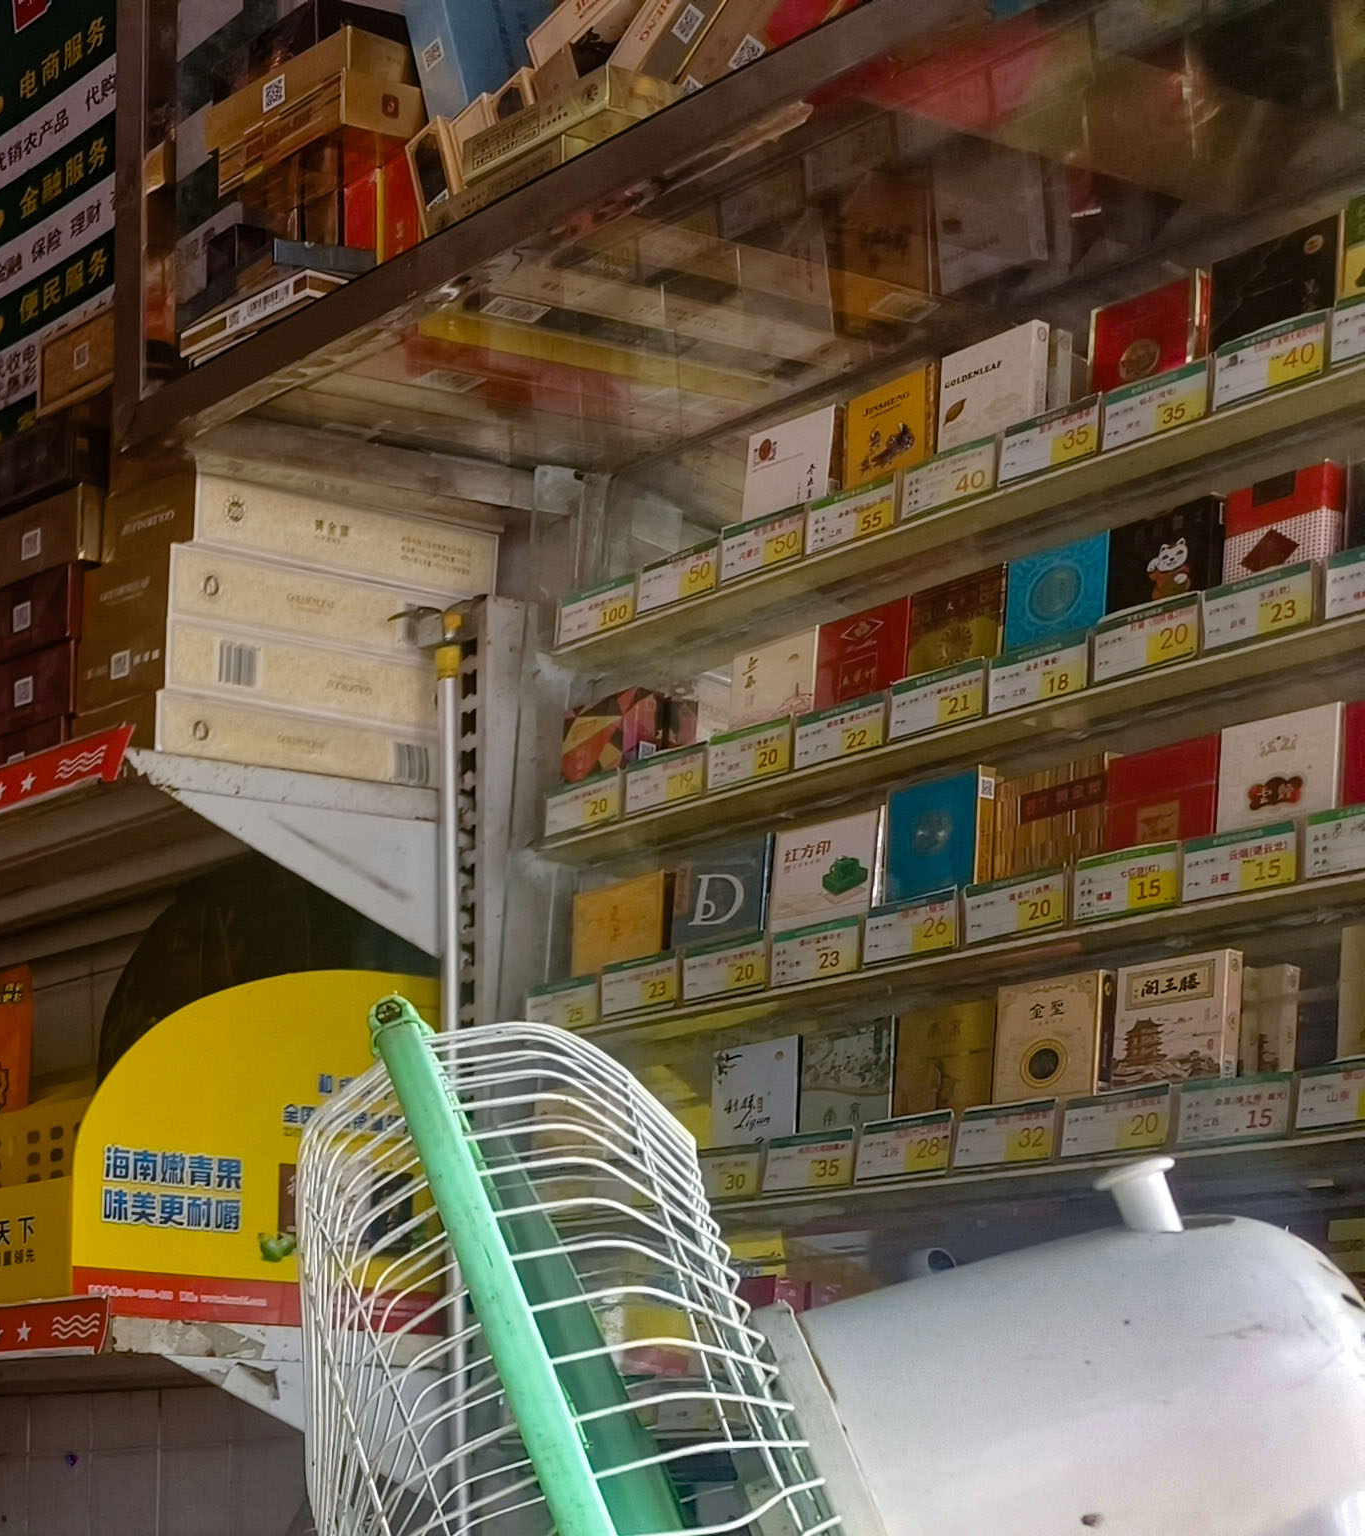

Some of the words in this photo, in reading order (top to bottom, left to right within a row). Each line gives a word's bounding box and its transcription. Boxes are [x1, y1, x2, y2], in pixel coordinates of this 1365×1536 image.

[18, 15, 107, 100] 电商服务
[18, 135, 109, 219] 金融服务
[30, 228, 62, 263] 保险
[69, 201, 103, 238] 理财
[18, 247, 109, 325] 便民服务
[1283, 342, 1315, 369] 40
[944, 360, 1003, 390] GOLDENLEAF
[1161, 404, 1186, 425] 35
[1062, 424, 1089, 451] 35
[955, 470, 986, 493] 40
[859, 510, 883, 533] 55
[772, 531, 799, 555] 50
[687, 560, 711, 585] 50
[600, 604, 628, 624] 100
[1269, 599, 1297, 624] 23
[1159, 622, 1189, 652] 20
[1047, 672, 1070, 695] 18
[948, 693, 970, 716] 21
[846, 729, 867, 750] 22
[757, 748, 778, 769] 20
[677, 770, 695, 789] 19
[589, 798, 608, 817] 20
[1254, 858, 1282, 882] 15
[1135, 880, 1161, 902] 15
[1028, 898, 1051, 921] 20
[921, 916, 948, 939] 26
[818, 950, 840, 970] 23
[735, 963, 755, 983] 20
[648, 980, 668, 1000] 23
[1129, 1111, 1159, 1138] 20
[1245, 1107, 1273, 1130] 15
[915, 1137, 940, 1161] 28
[1018, 1126, 1045, 1149] 32
[103, 1143, 244, 1190] 海南嫩青果
[815, 1158, 841, 1179] 35
[724, 1173, 747, 1192] 30
[101, 1186, 243, 1233] 味美更耐嚼
